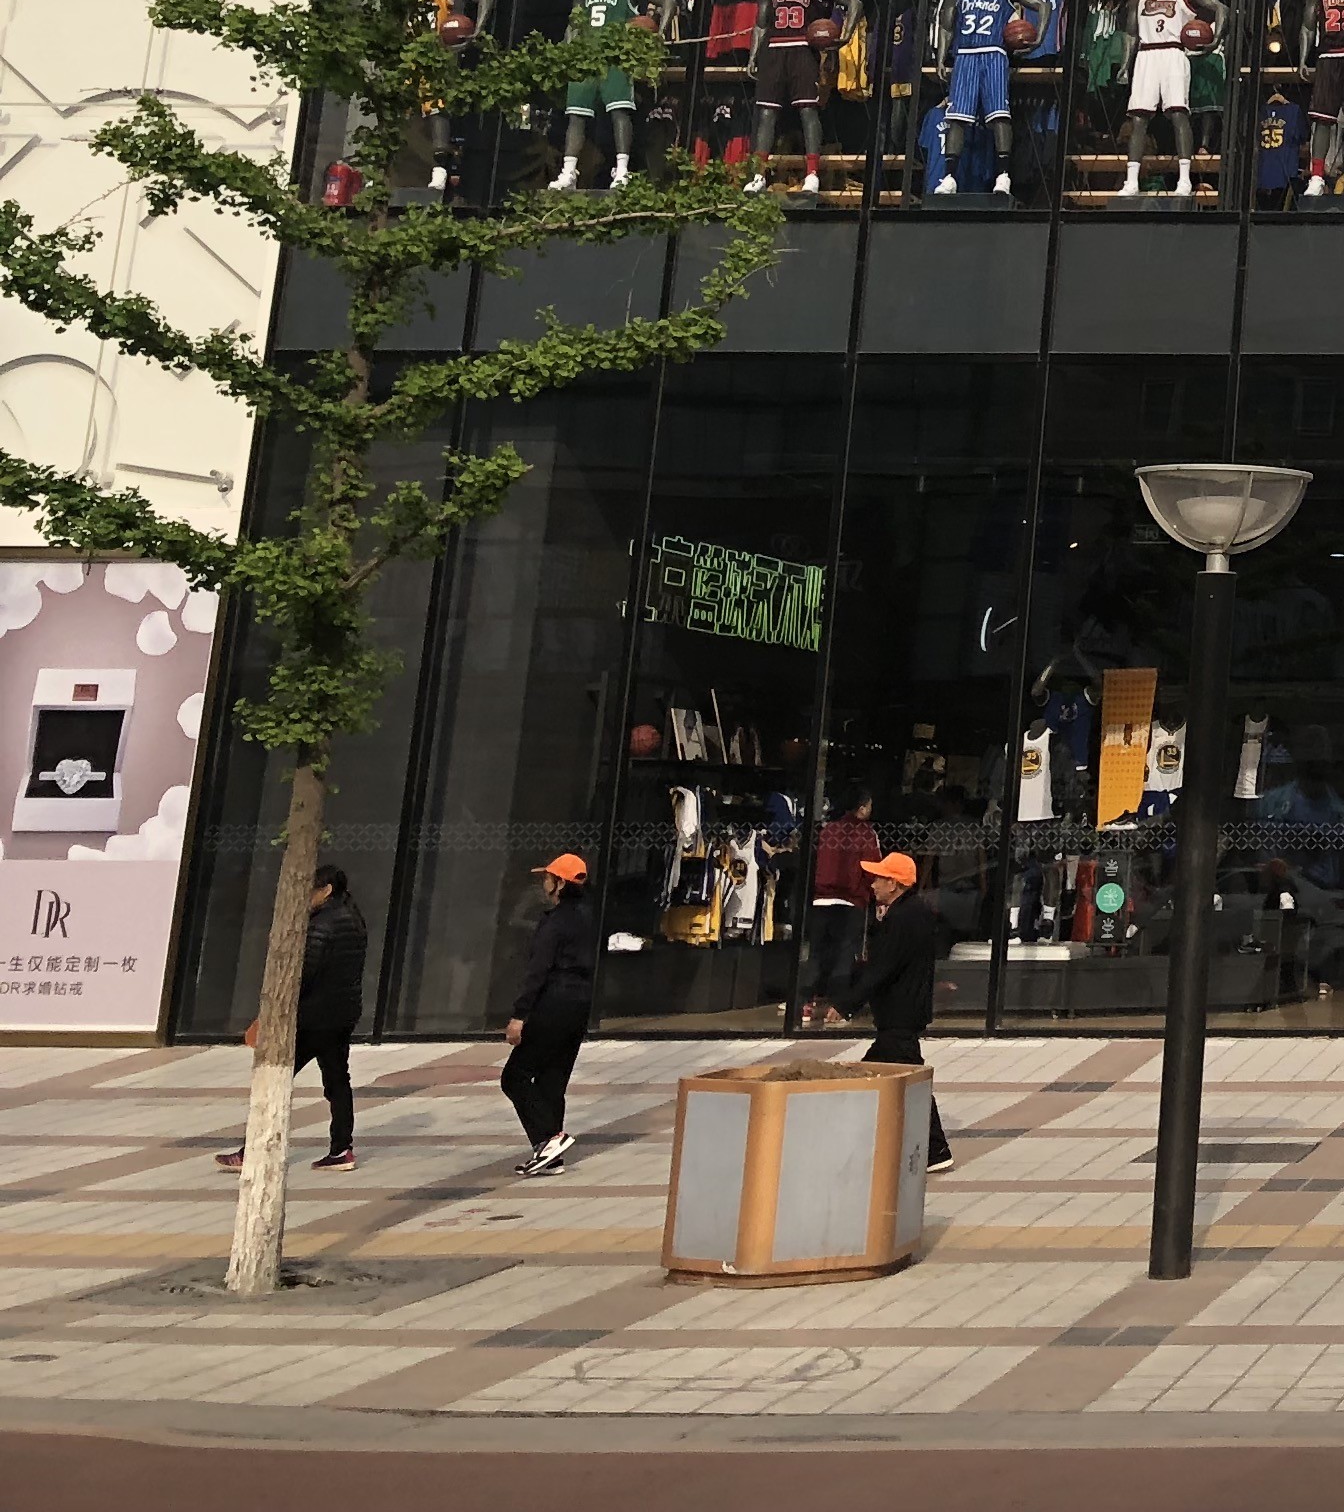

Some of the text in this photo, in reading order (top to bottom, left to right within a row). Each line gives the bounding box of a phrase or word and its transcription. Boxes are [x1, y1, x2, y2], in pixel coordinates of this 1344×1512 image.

[590, 5, 607, 27] 5
[775, 6, 805, 29] 33
[961, 14, 994, 36] 32
[1155, 19, 1165, 33] 3
[31, 889, 71, 938] DR
